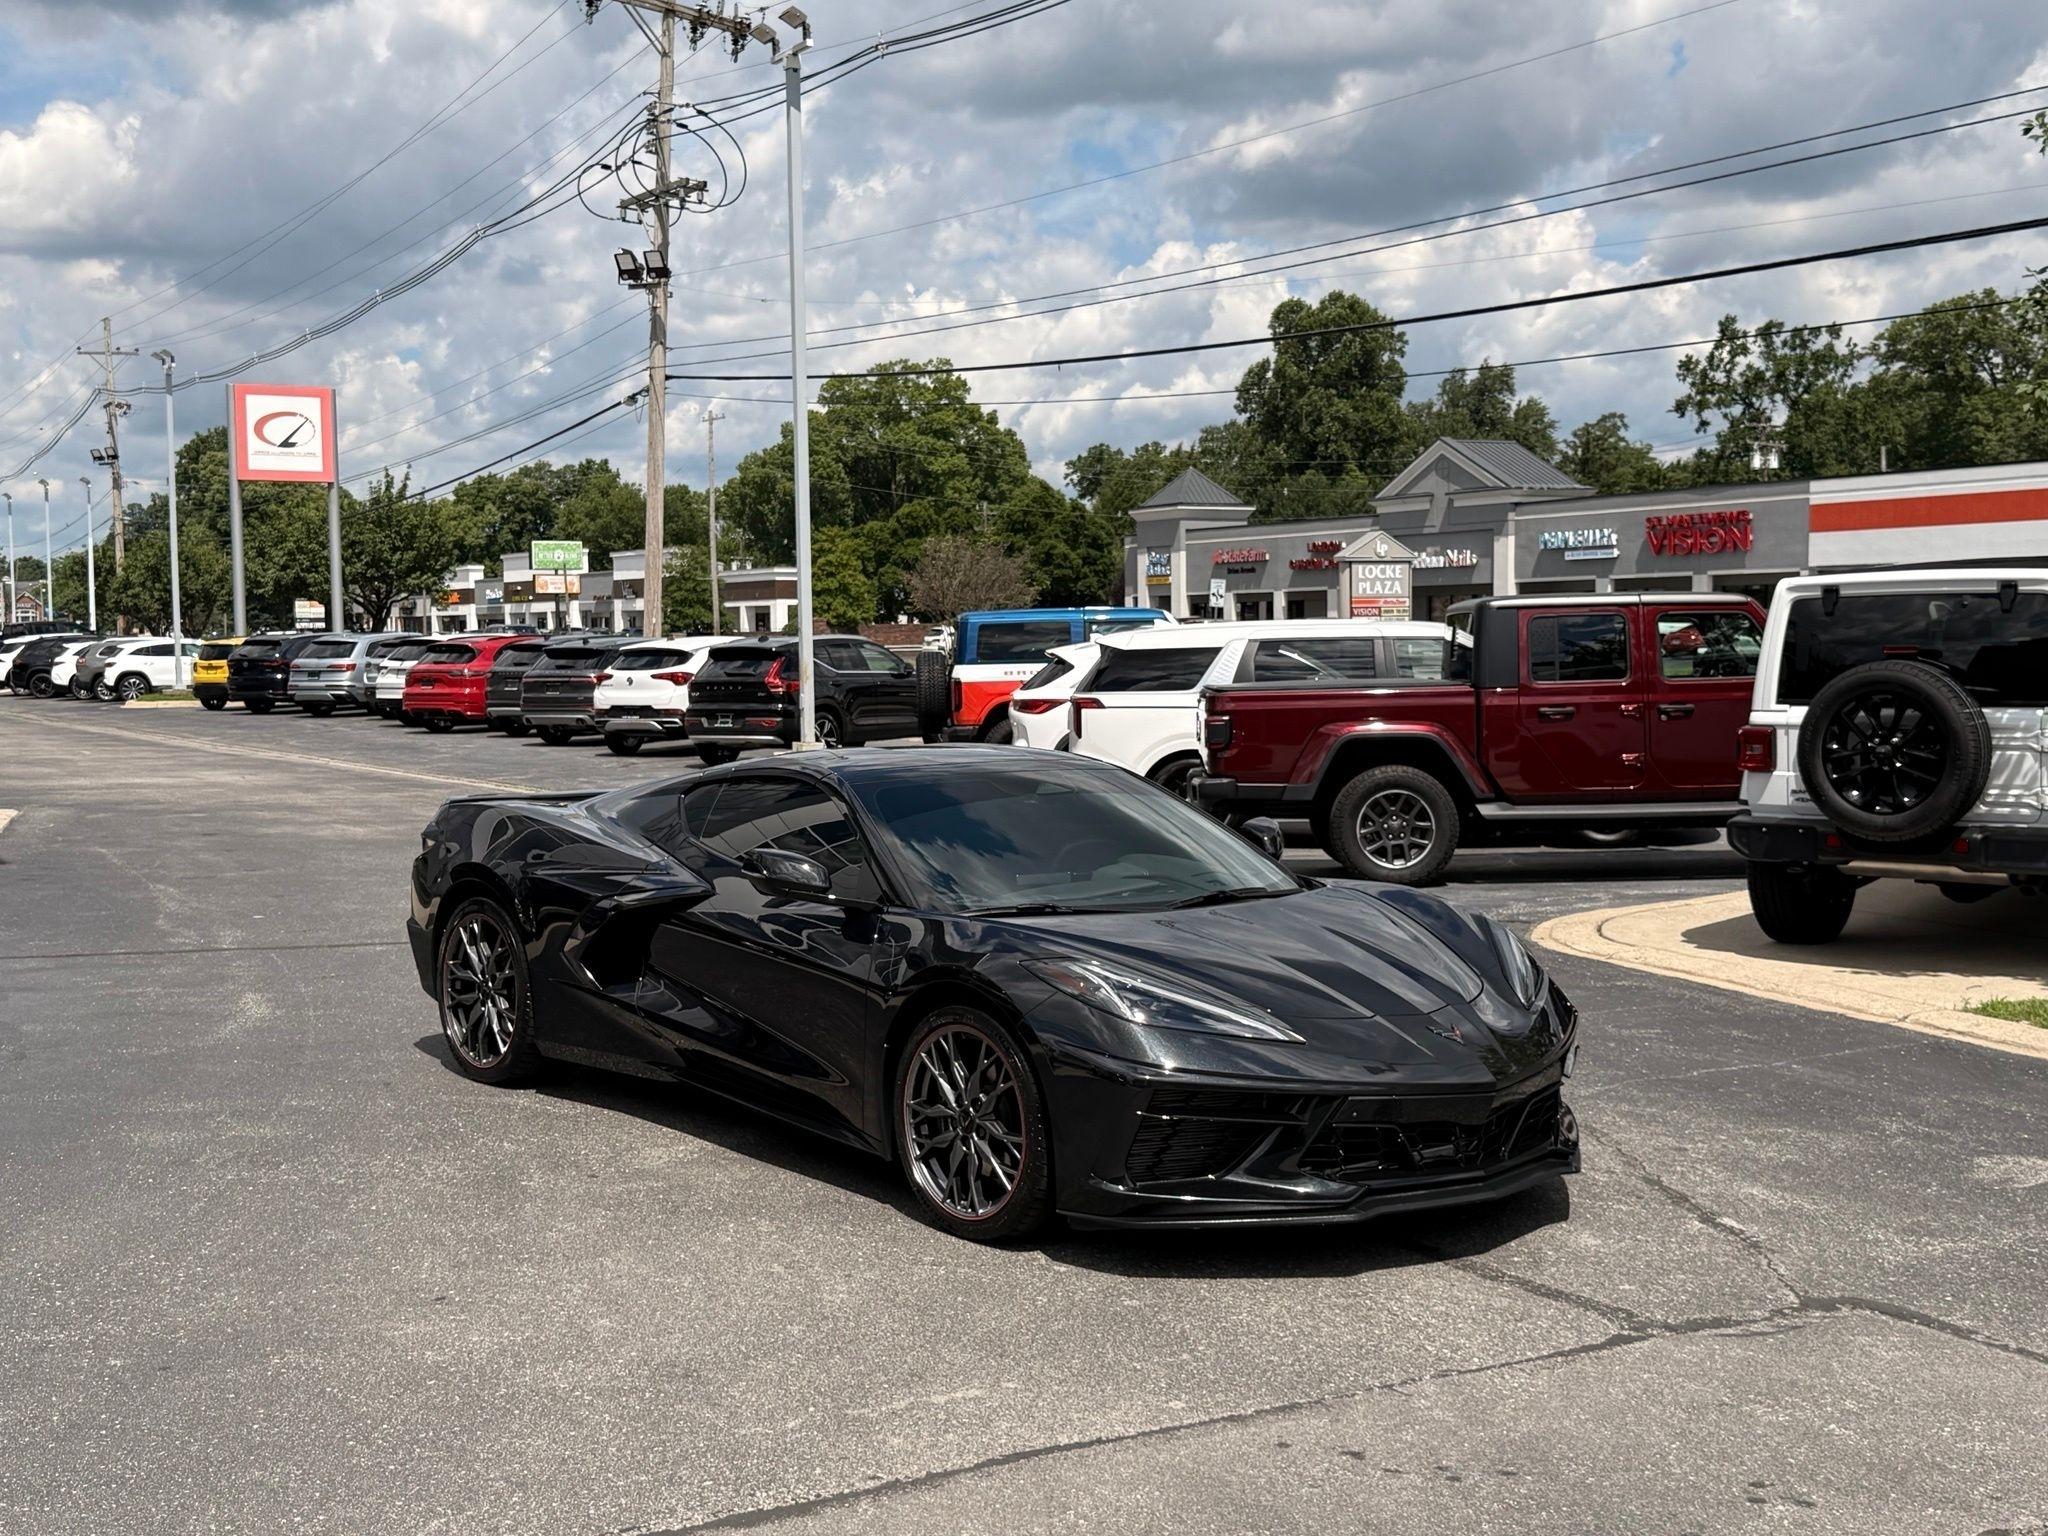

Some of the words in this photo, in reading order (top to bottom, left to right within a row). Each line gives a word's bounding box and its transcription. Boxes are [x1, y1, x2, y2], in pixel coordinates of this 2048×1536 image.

[1647, 525, 1754, 557] VISION
[1358, 564, 1404, 579] LOCKE
[1358, 580, 1402, 595] PLAZA
[1352, 608, 1379, 616] VISION
